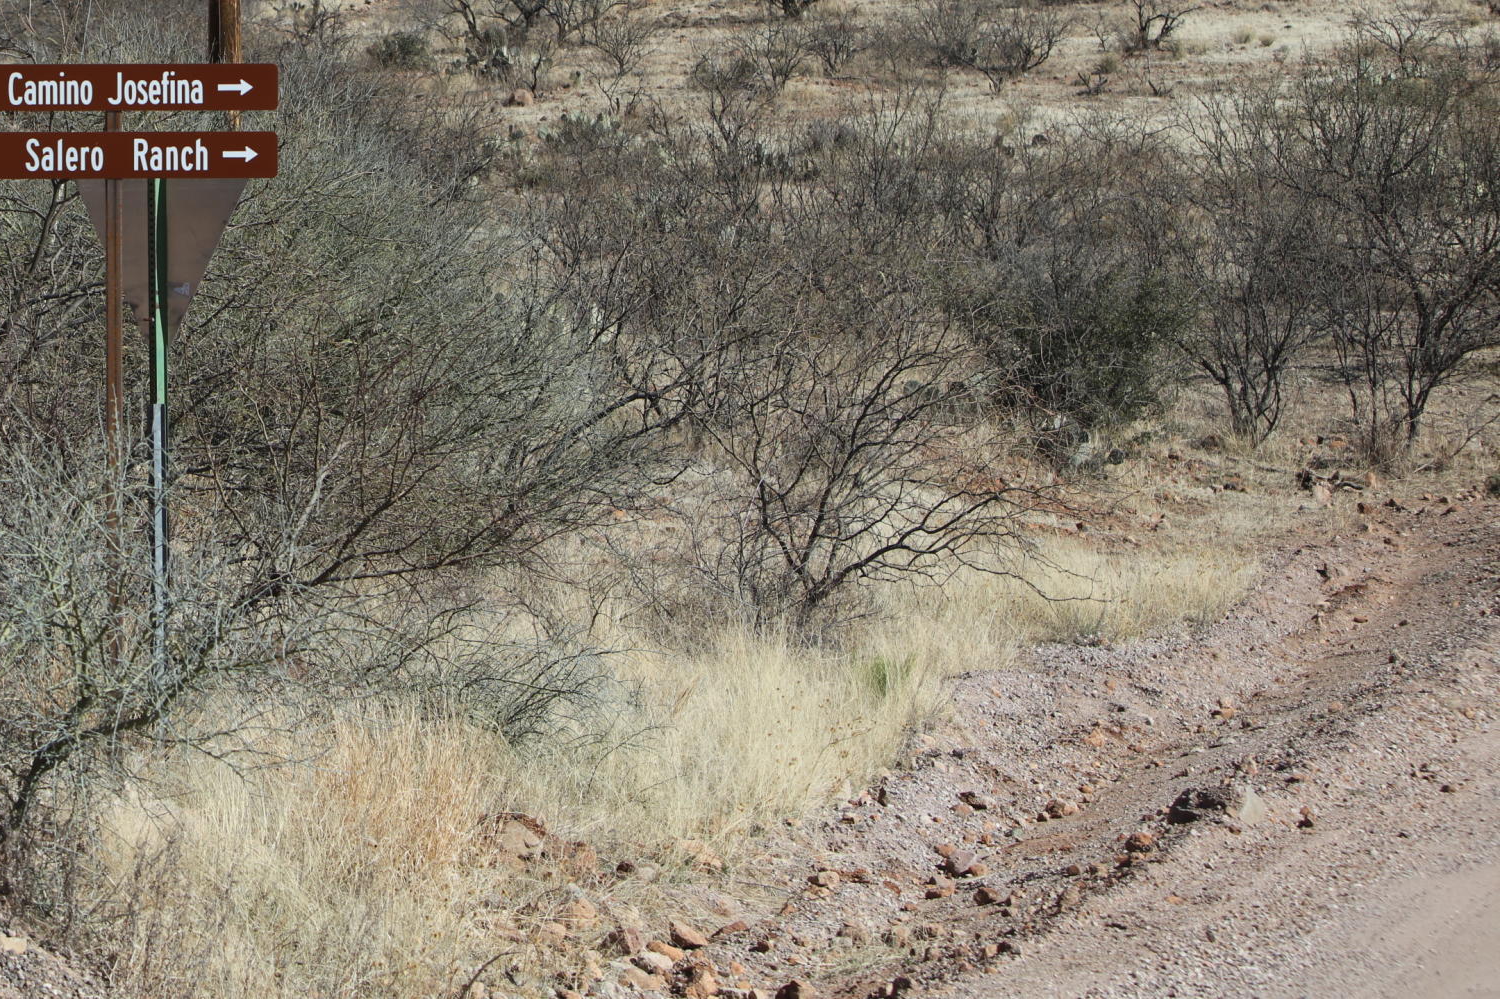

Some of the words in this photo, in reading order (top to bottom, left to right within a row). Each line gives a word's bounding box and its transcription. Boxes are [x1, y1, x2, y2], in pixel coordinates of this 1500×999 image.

[8, 72, 93, 105] Camino
[107, 71, 203, 105] Josefina
[25, 138, 104, 172] Salero
[133, 138, 208, 171] Ranch
